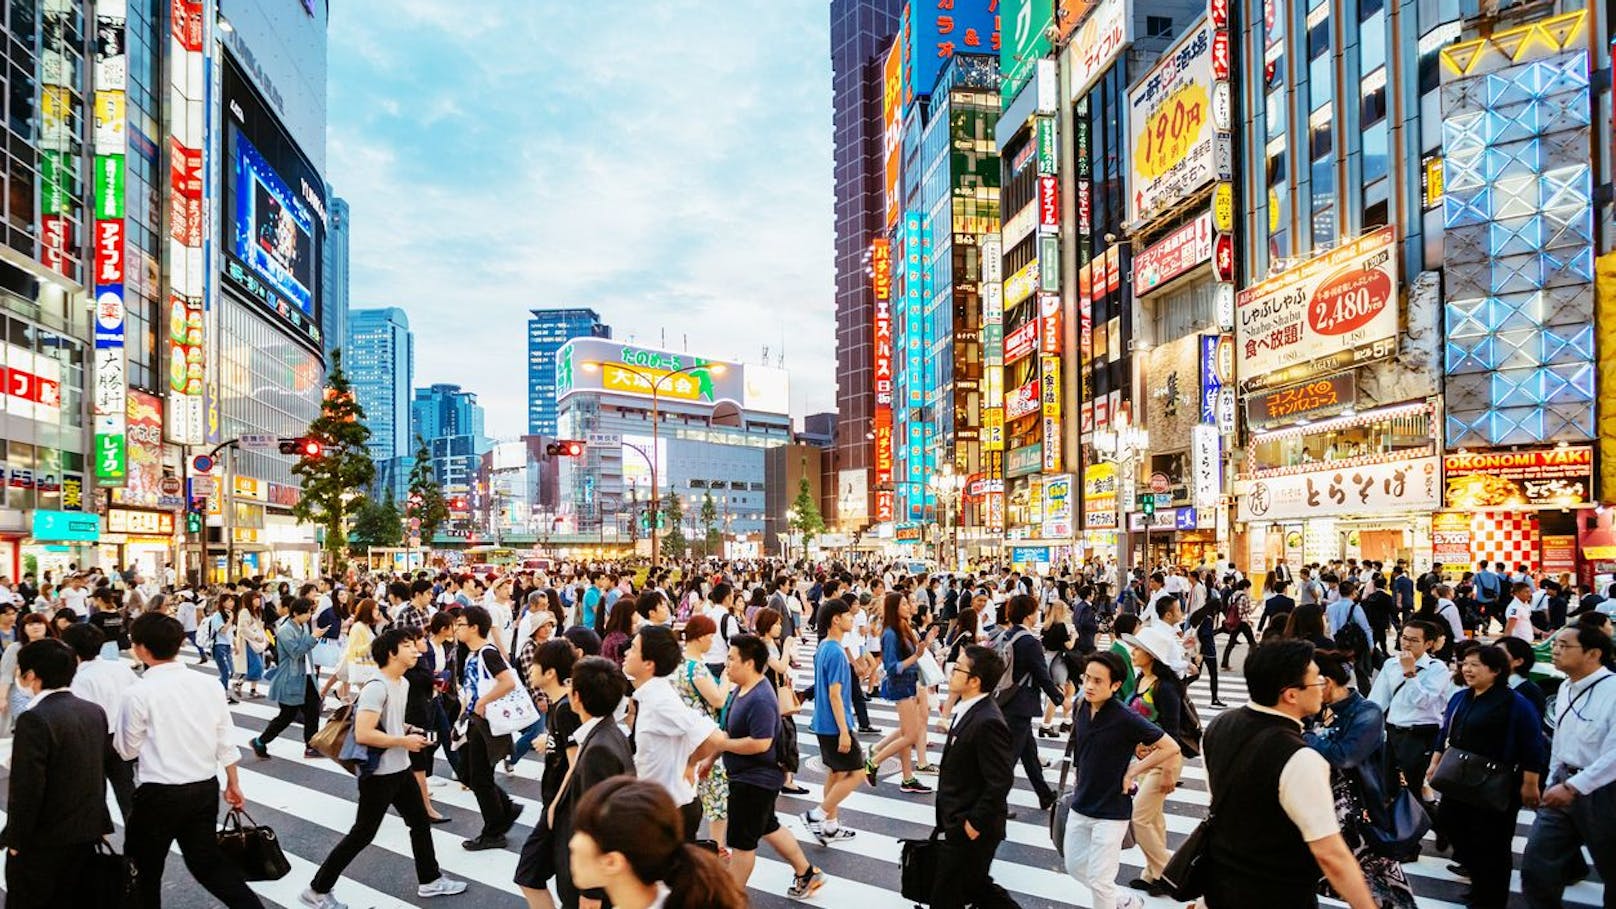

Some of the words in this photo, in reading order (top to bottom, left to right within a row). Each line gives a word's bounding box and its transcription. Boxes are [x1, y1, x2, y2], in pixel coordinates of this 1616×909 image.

[1085, 26, 1122, 78] アイフル
[1146, 99, 1200, 163] 190円
[1044, 188, 1055, 225] アイフル
[101, 222, 121, 280] アイフル
[876, 245, 888, 300] パチンコ
[1241, 287, 1306, 326] しゃぶしゃぶ
[1314, 286, 1368, 332] 2,480
[620, 347, 681, 371] たのめーる
[1244, 320, 1305, 360] 食べ放題!
[611, 370, 693, 395] 大塚商会
[1268, 391, 1338, 418] キャンパスコース
[102, 436, 119, 472] レイク
[879, 426, 890, 469] パチンコ
[1445, 453, 1537, 470] OKONOMI
[1541, 450, 1590, 464] YAKI
[1305, 463, 1414, 508] とらそば
